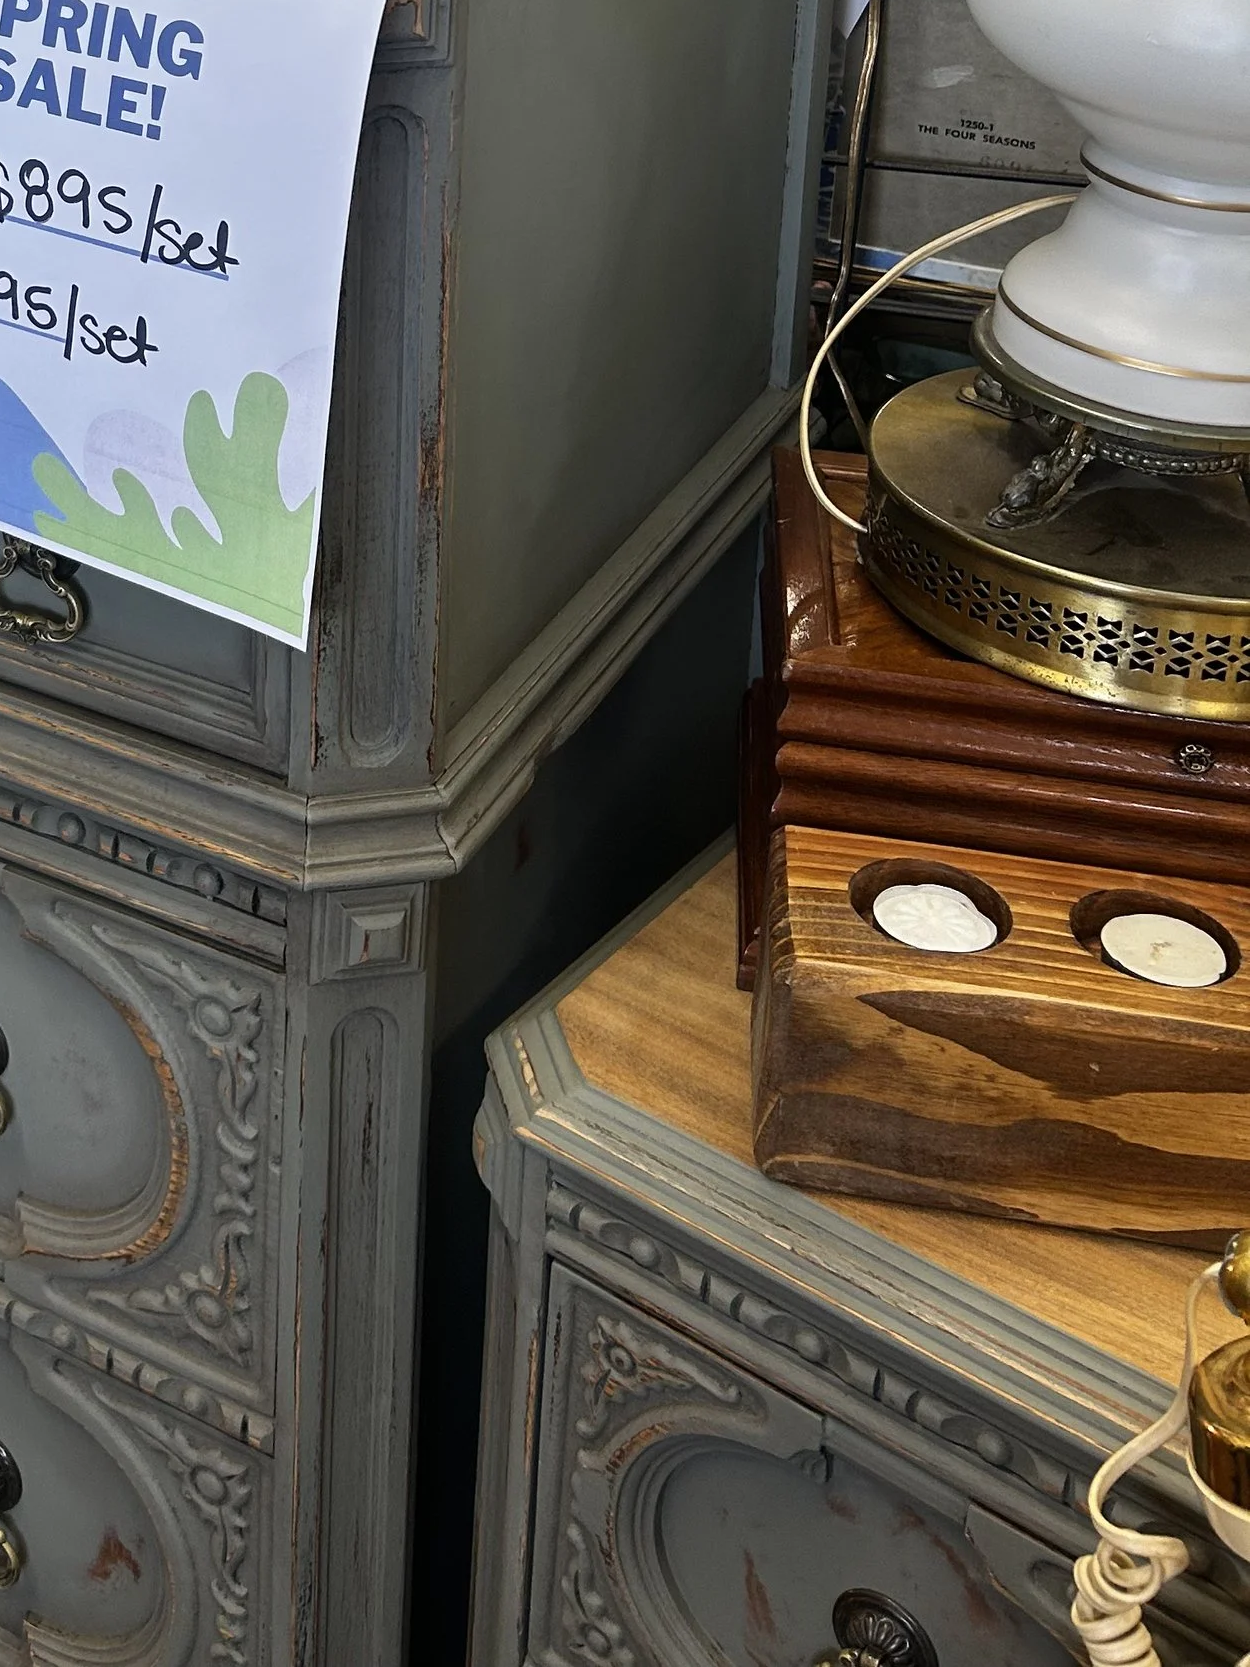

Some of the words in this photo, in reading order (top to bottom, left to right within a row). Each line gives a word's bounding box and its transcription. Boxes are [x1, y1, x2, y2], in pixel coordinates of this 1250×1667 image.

[960, 119, 994, 132] 1250-1
[918, 124, 938, 135] THE
[945, 129, 976, 141] FOUR
[982, 134, 1036, 150] SEASONS
